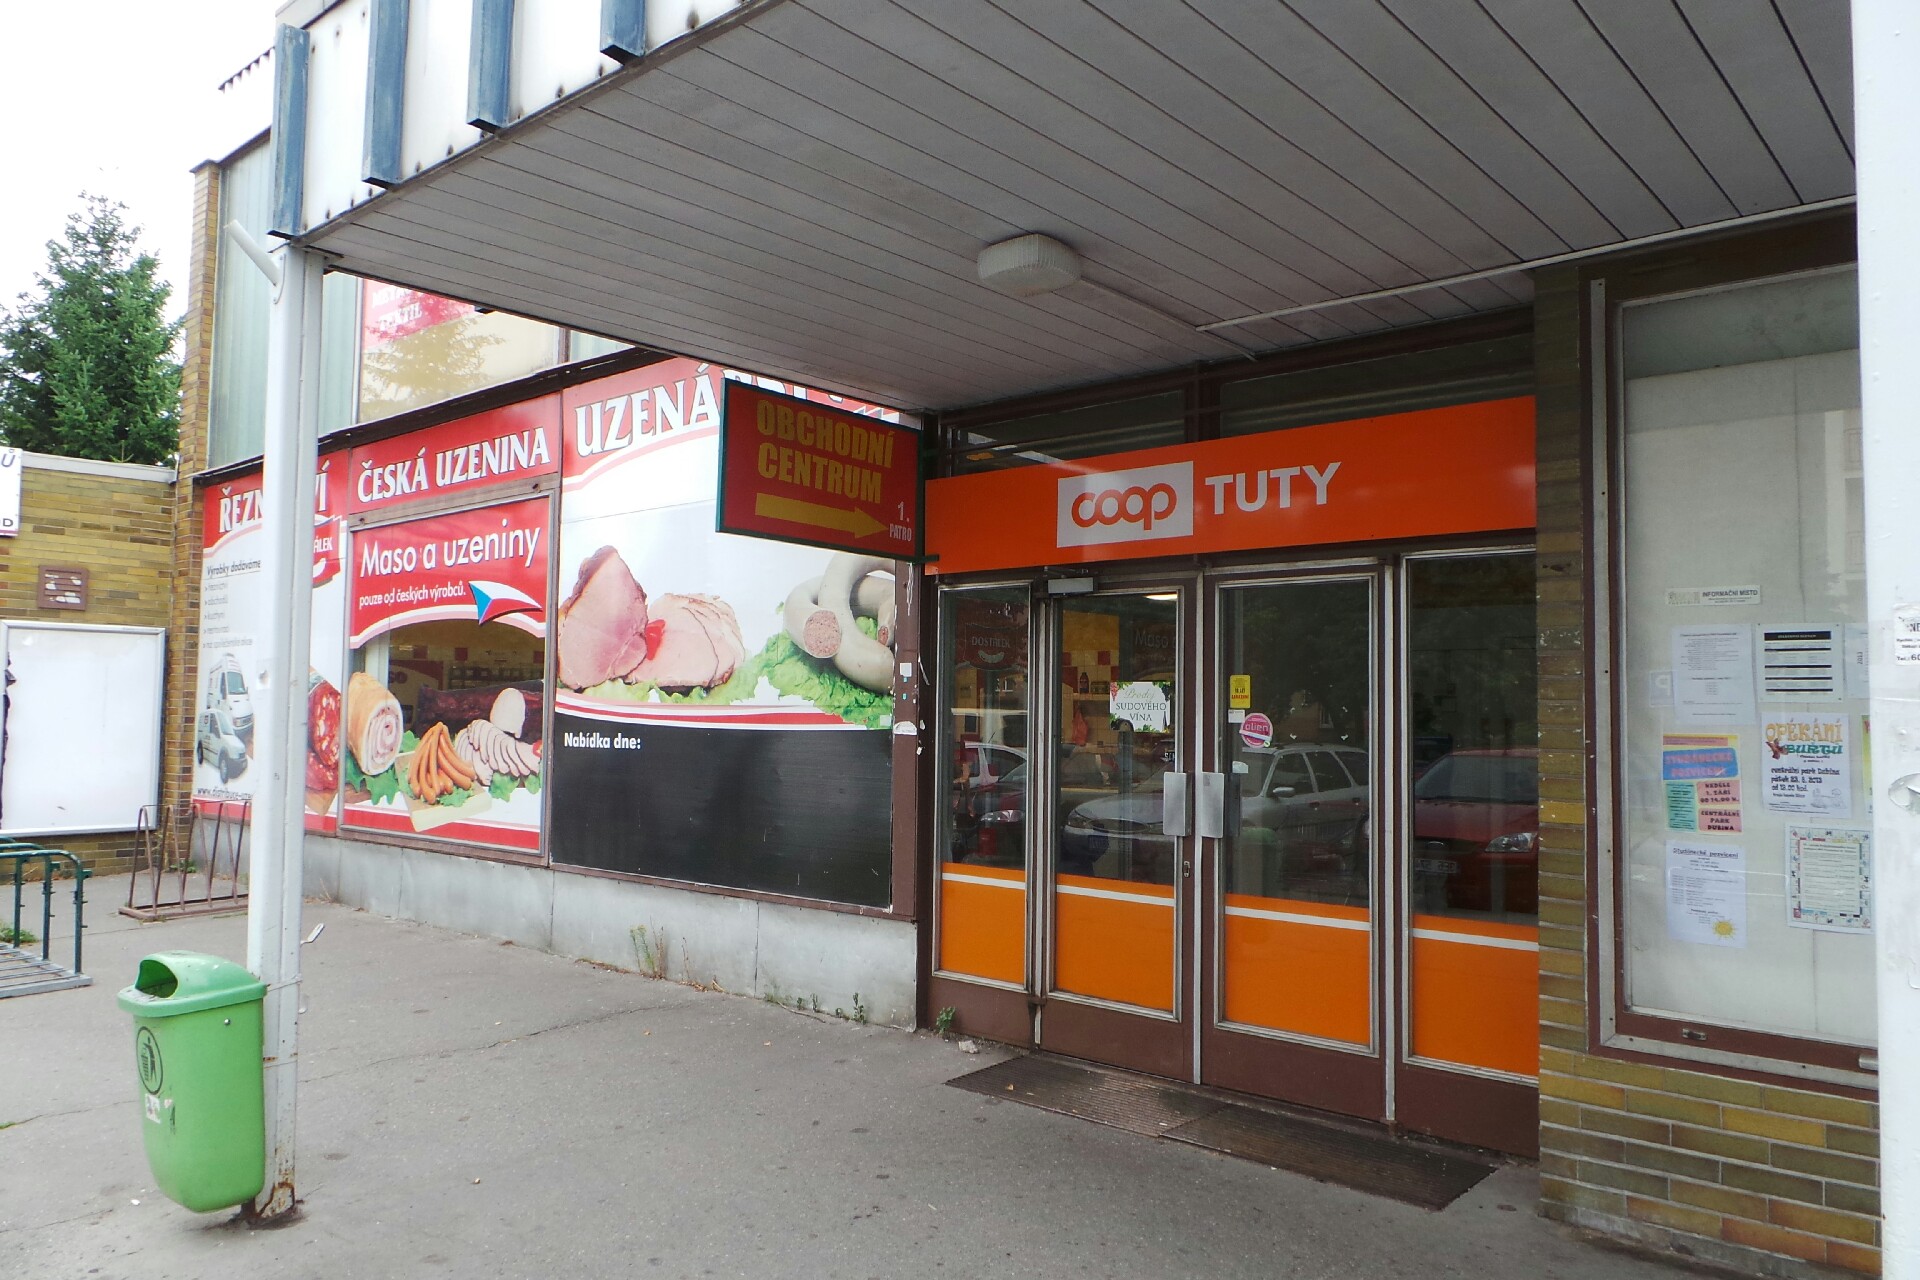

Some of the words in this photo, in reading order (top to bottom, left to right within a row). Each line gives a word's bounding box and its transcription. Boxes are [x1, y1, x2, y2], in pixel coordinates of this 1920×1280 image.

[757, 400, 895, 468] OBCHODNÍ
[357, 447, 429, 503] ČESKÁ
[435, 427, 550, 487] UZENINA
[758, 442, 882, 504] CENTRUM
[897, 501, 910, 523] 1.
[1071, 482, 1178, 531] coop
[1205, 461, 1342, 515] TUTY
[360, 541, 417, 578] Maso
[422, 543, 436, 570] a
[443, 518, 541, 568] uzeniny
[889, 523, 912, 542] PATRO
[358, 593, 382, 609] pouze
[384, 588, 395, 605] od
[396, 583, 429, 604] českých
[430, 580, 466, 601] výrobců.
[1129, 711, 1152, 722] VÍNA
[564, 732, 610, 749] Nabídka
[613, 734, 641, 749] dne:
